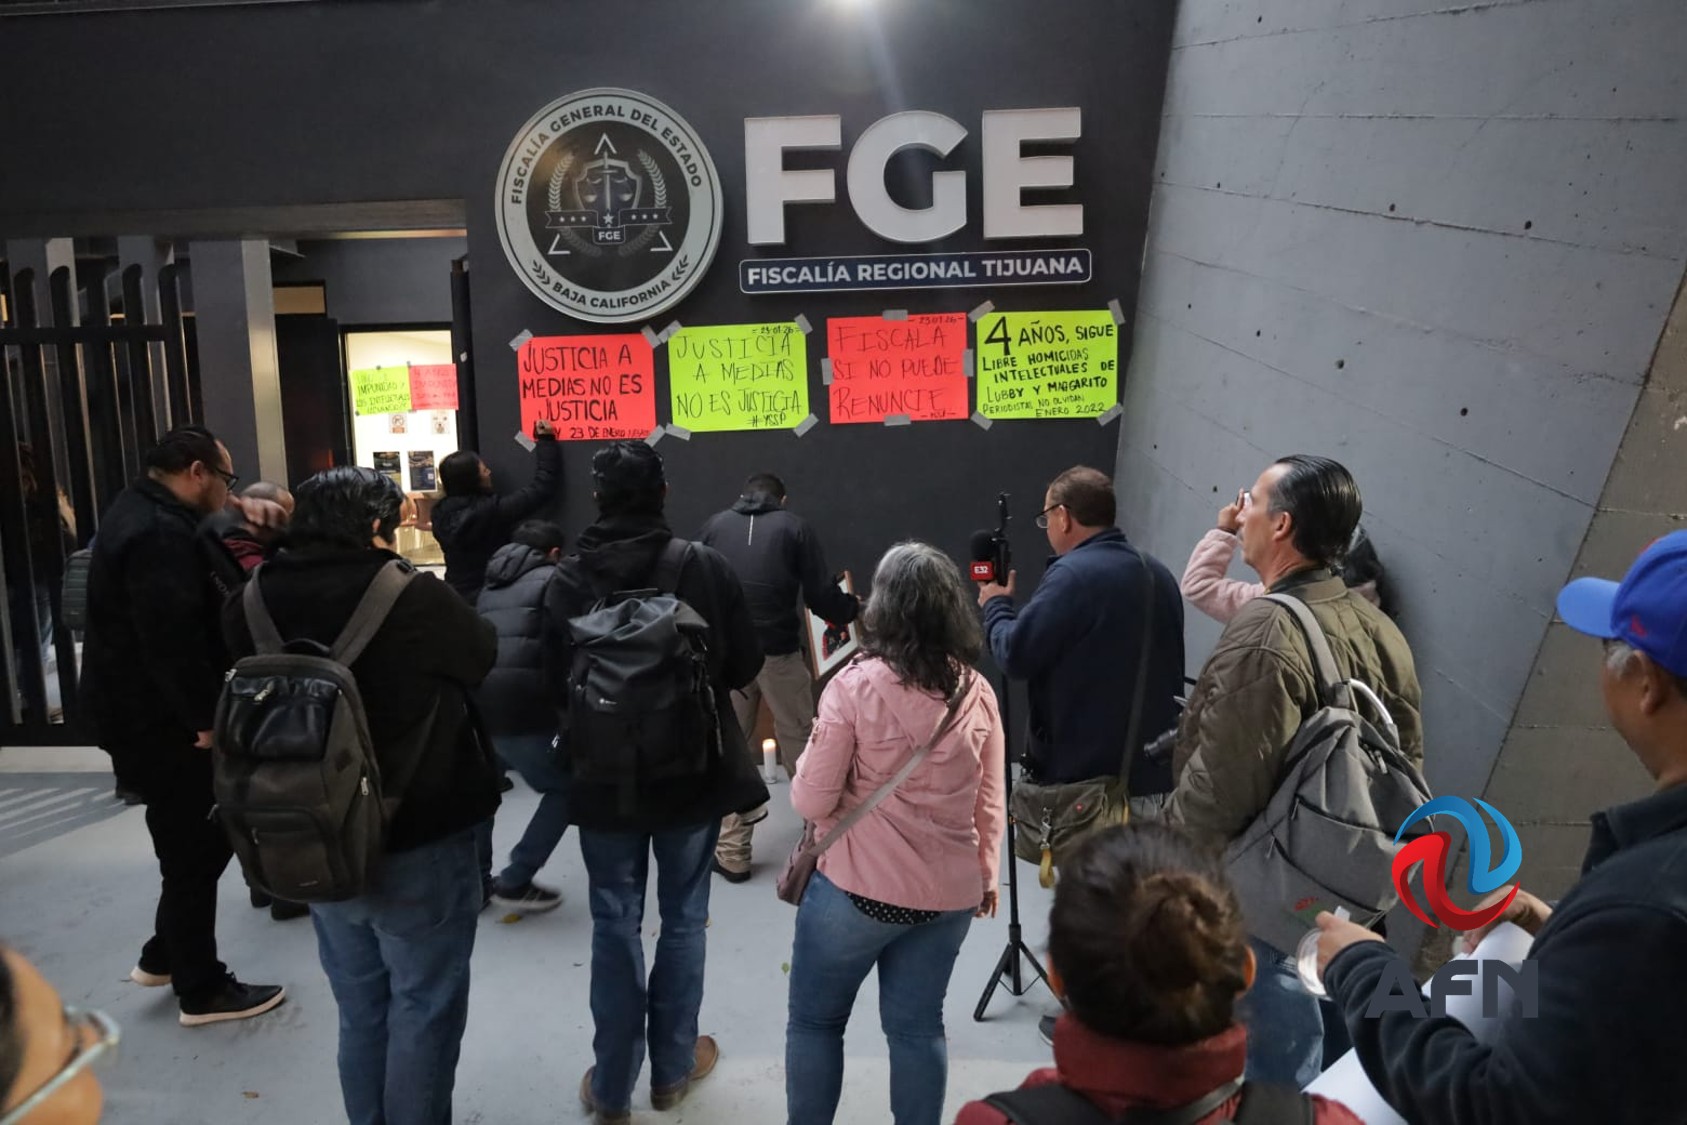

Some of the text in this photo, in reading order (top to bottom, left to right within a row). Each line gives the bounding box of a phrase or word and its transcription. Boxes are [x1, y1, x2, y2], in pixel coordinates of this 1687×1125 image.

[511, 105, 702, 205] FISCALÍA GENERAL DEL ESTADO
[744, 107, 1083, 245] FGE
[597, 230, 621, 241] FGE
[747, 256, 1084, 285] FISCALÍA REGIONAL TIJUANA
[553, 280, 671, 309] BAJA CALIFORNIA
[676, 333, 791, 359] JUSTICIA
[835, 325, 946, 352] FISCALA
[984, 316, 1114, 356] 4 AÑOS, SIGUE
[523, 340, 632, 375] JUSTICIA A
[833, 355, 959, 380] SI NO PUEDE
[982, 348, 1089, 371] LIBRE HOMICIDAS
[693, 359, 794, 385] A MEDIAS
[994, 360, 1115, 383] INTELECTUALES DE
[522, 374, 642, 398] MEDIAS NO ES
[987, 386, 1024, 403] LUBBY
[1033, 385, 1041, 395] Y
[538, 398, 618, 422] JUSTICIA
[676, 387, 801, 419] NO ES JUSTICIA
[833, 387, 949, 419] RENUNCIE
[1036, 402, 1107, 418] ENERO 2022
[1038, 398, 1050, 407] NO
[570, 426, 584, 439] 23
[588, 426, 600, 438] DE
